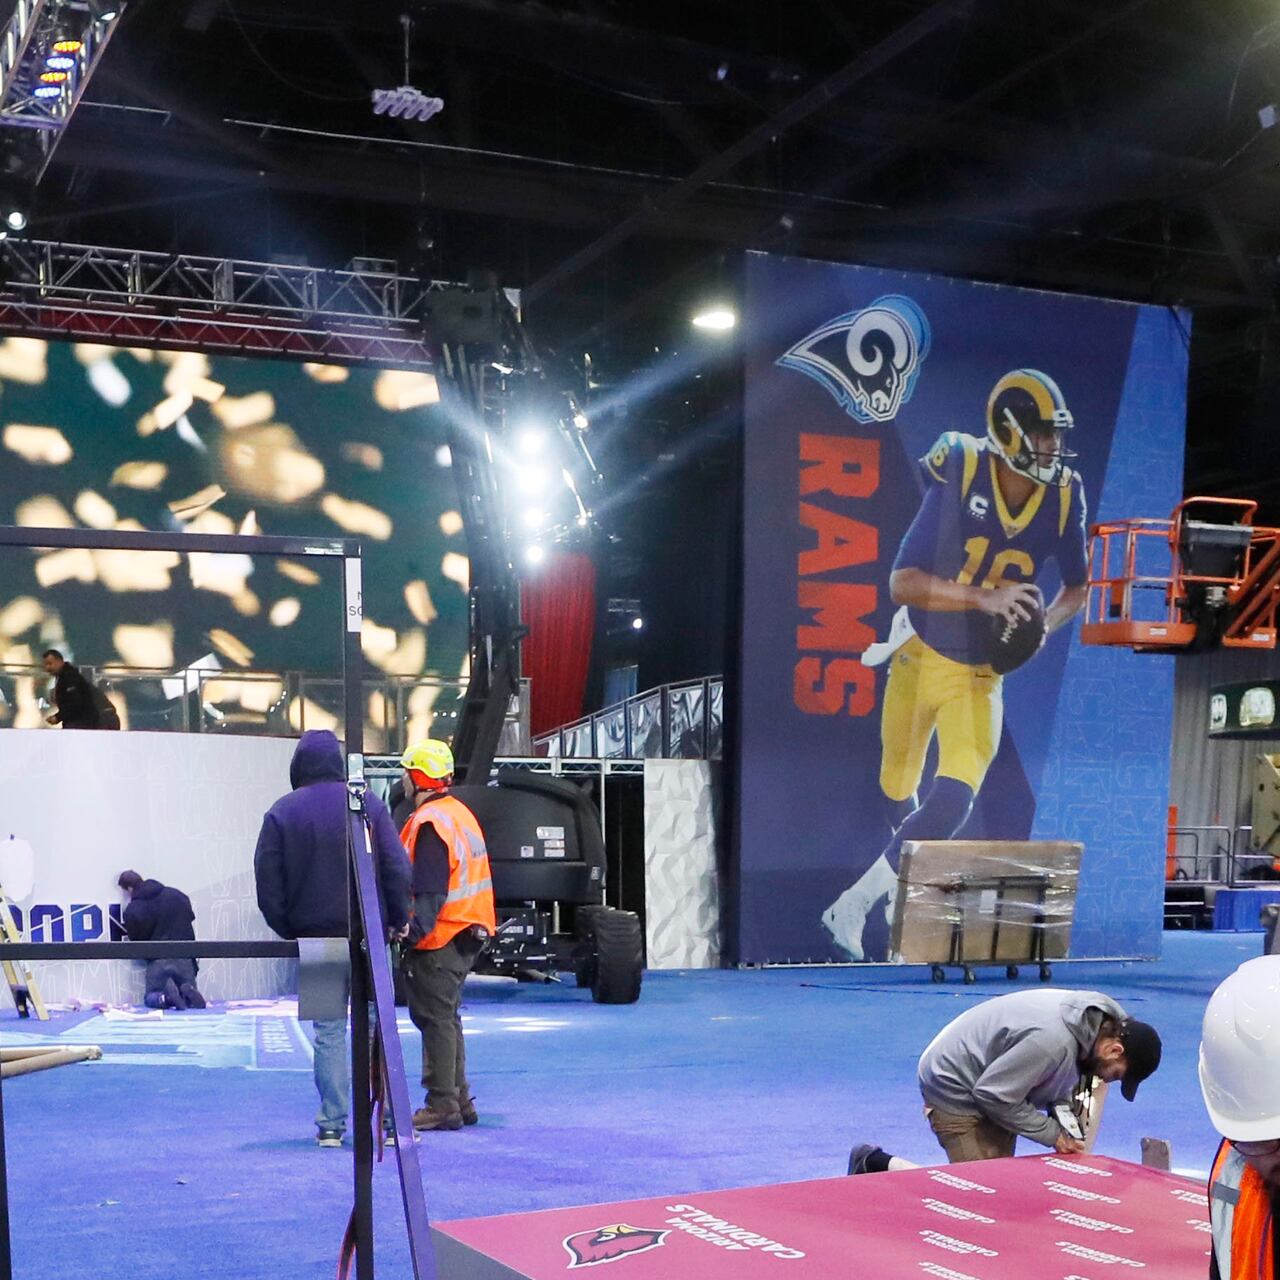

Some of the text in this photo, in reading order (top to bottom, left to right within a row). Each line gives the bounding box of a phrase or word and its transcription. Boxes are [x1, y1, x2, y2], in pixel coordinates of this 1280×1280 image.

[792, 432, 882, 719] RAMS
[665, 1204, 805, 1259] CARDINALS
[665, 1217, 750, 1250] ARIZONA
[919, 1230, 999, 1257] CARDINALS
